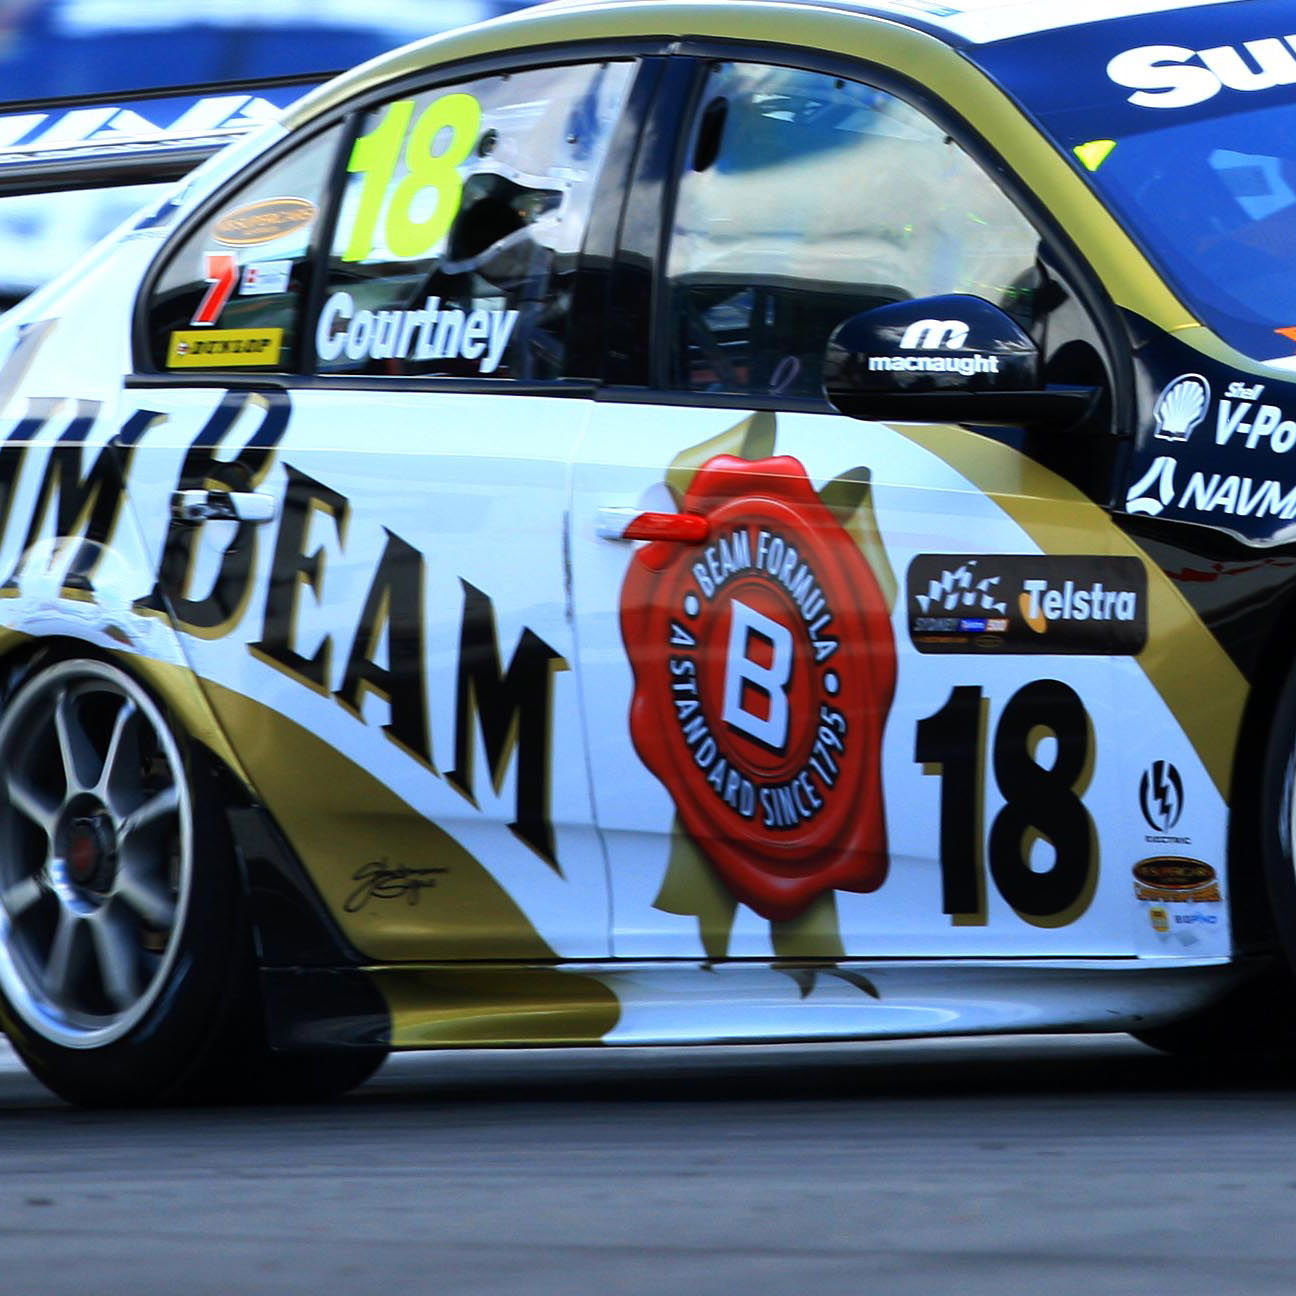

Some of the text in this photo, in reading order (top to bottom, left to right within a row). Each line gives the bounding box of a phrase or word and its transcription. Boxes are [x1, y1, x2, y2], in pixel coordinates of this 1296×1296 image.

[343, 92, 482, 263] 18
[316, 291, 519, 373] Courtney
[868, 353, 999, 376] macnaught
[1224, 381, 1264, 401] Shell
[133, 388, 571, 881] BEAM
[692, 530, 839, 662] BEAM FORMULA
[1023, 579, 1137, 621] Telstra
[670, 622, 847, 827] A STANDARD SINCE 1795
[722, 597, 796, 750] B
[915, 678, 1097, 927] 18
